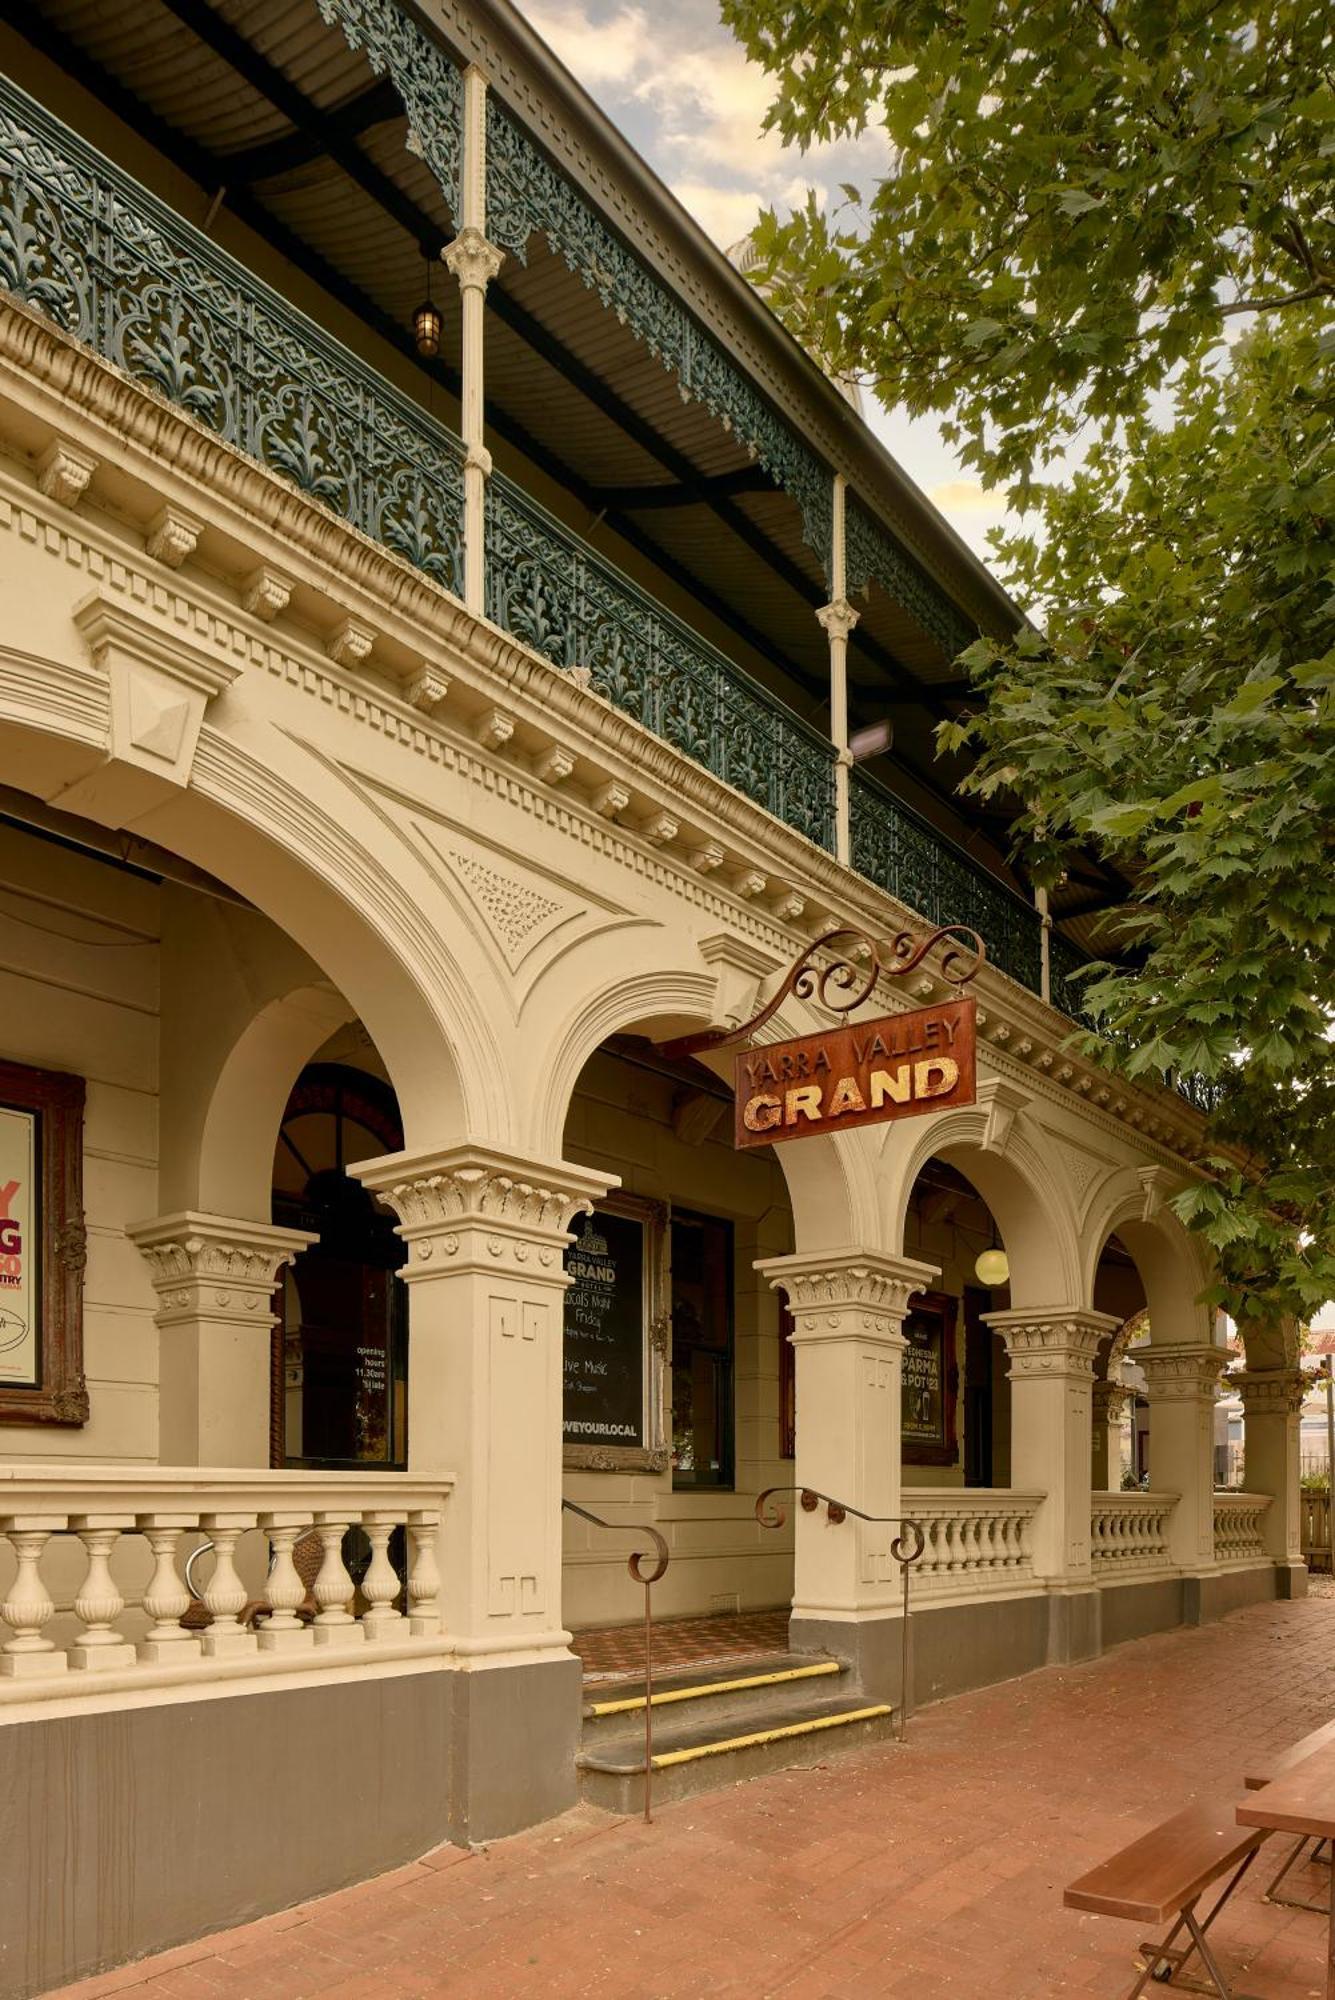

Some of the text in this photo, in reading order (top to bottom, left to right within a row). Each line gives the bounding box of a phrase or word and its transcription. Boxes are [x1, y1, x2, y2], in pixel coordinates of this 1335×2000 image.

[745, 1016, 961, 1089] YARRA VALLEY
[743, 1056, 961, 1132] GRAND
[567, 1260, 616, 1283] GRAND
[356, 1347, 385, 1358] opening
[365, 1357, 385, 1368] hours
[563, 1356, 580, 1374] ive
[901, 1356, 938, 1376] PARMA
[355, 1367, 385, 1379] 11.30am
